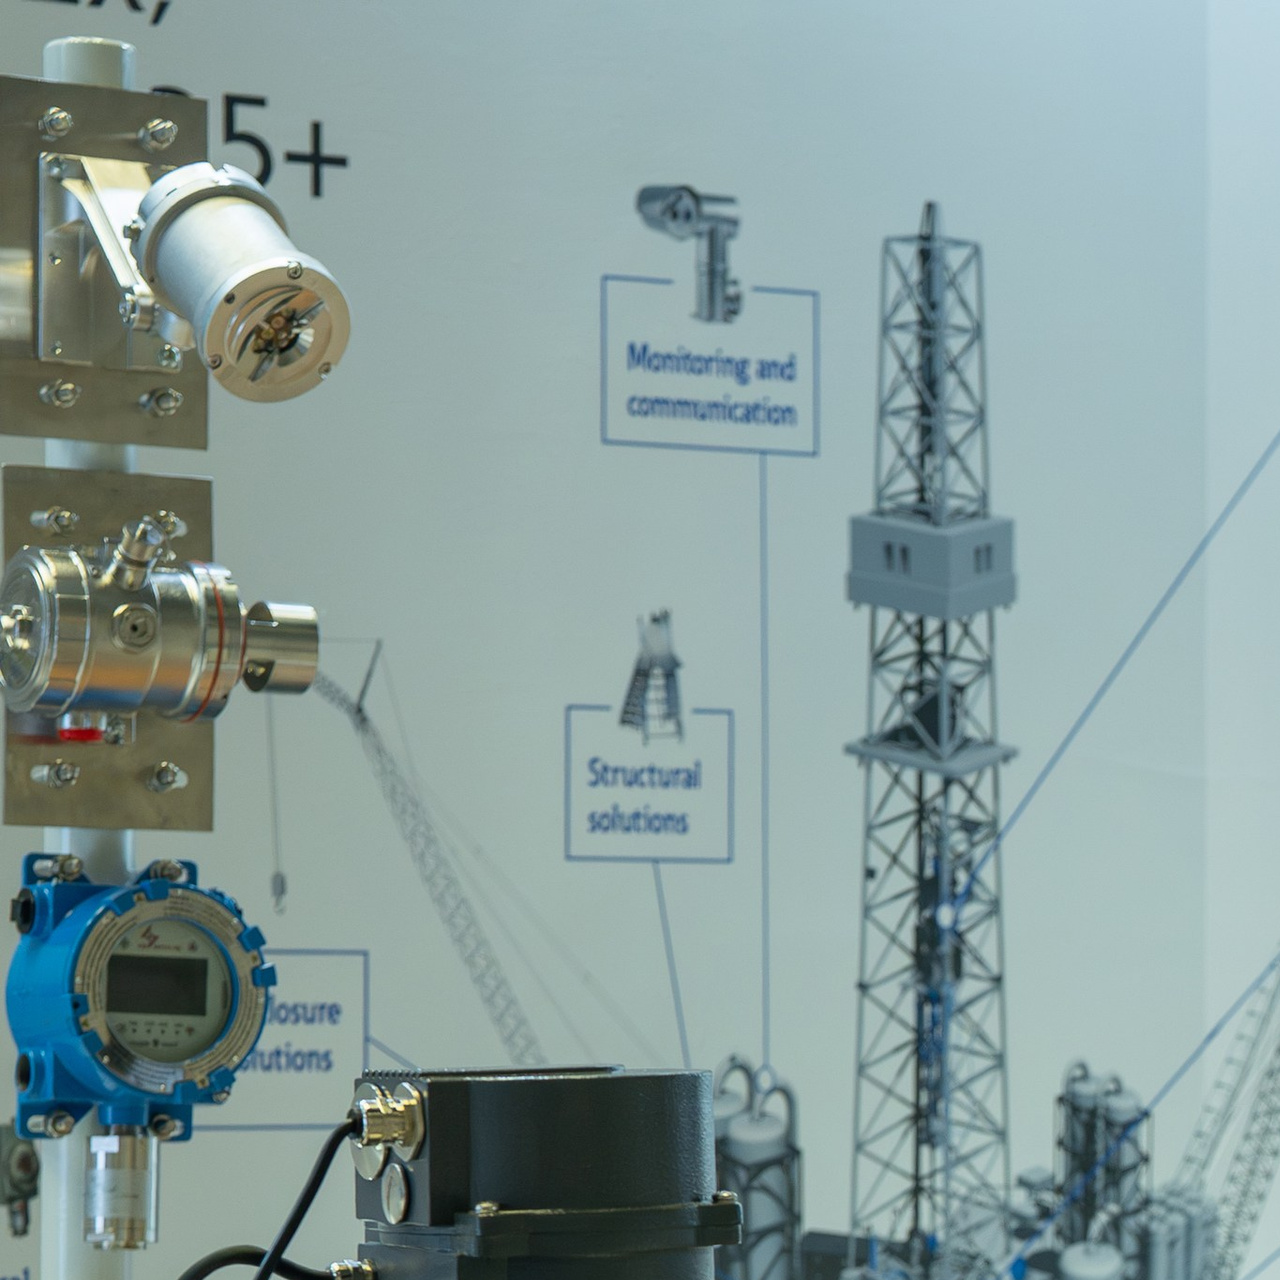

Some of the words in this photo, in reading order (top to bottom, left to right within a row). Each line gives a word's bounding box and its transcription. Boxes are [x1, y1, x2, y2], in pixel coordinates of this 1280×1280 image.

[627, 340, 751, 386] Monitoring
[756, 353, 797, 382] and
[626, 393, 798, 426] communication
[587, 756, 702, 790] Structural
[587, 801, 690, 834] solutions
[267, 993, 343, 1026] losure
[238, 1040, 333, 1074] olutions
